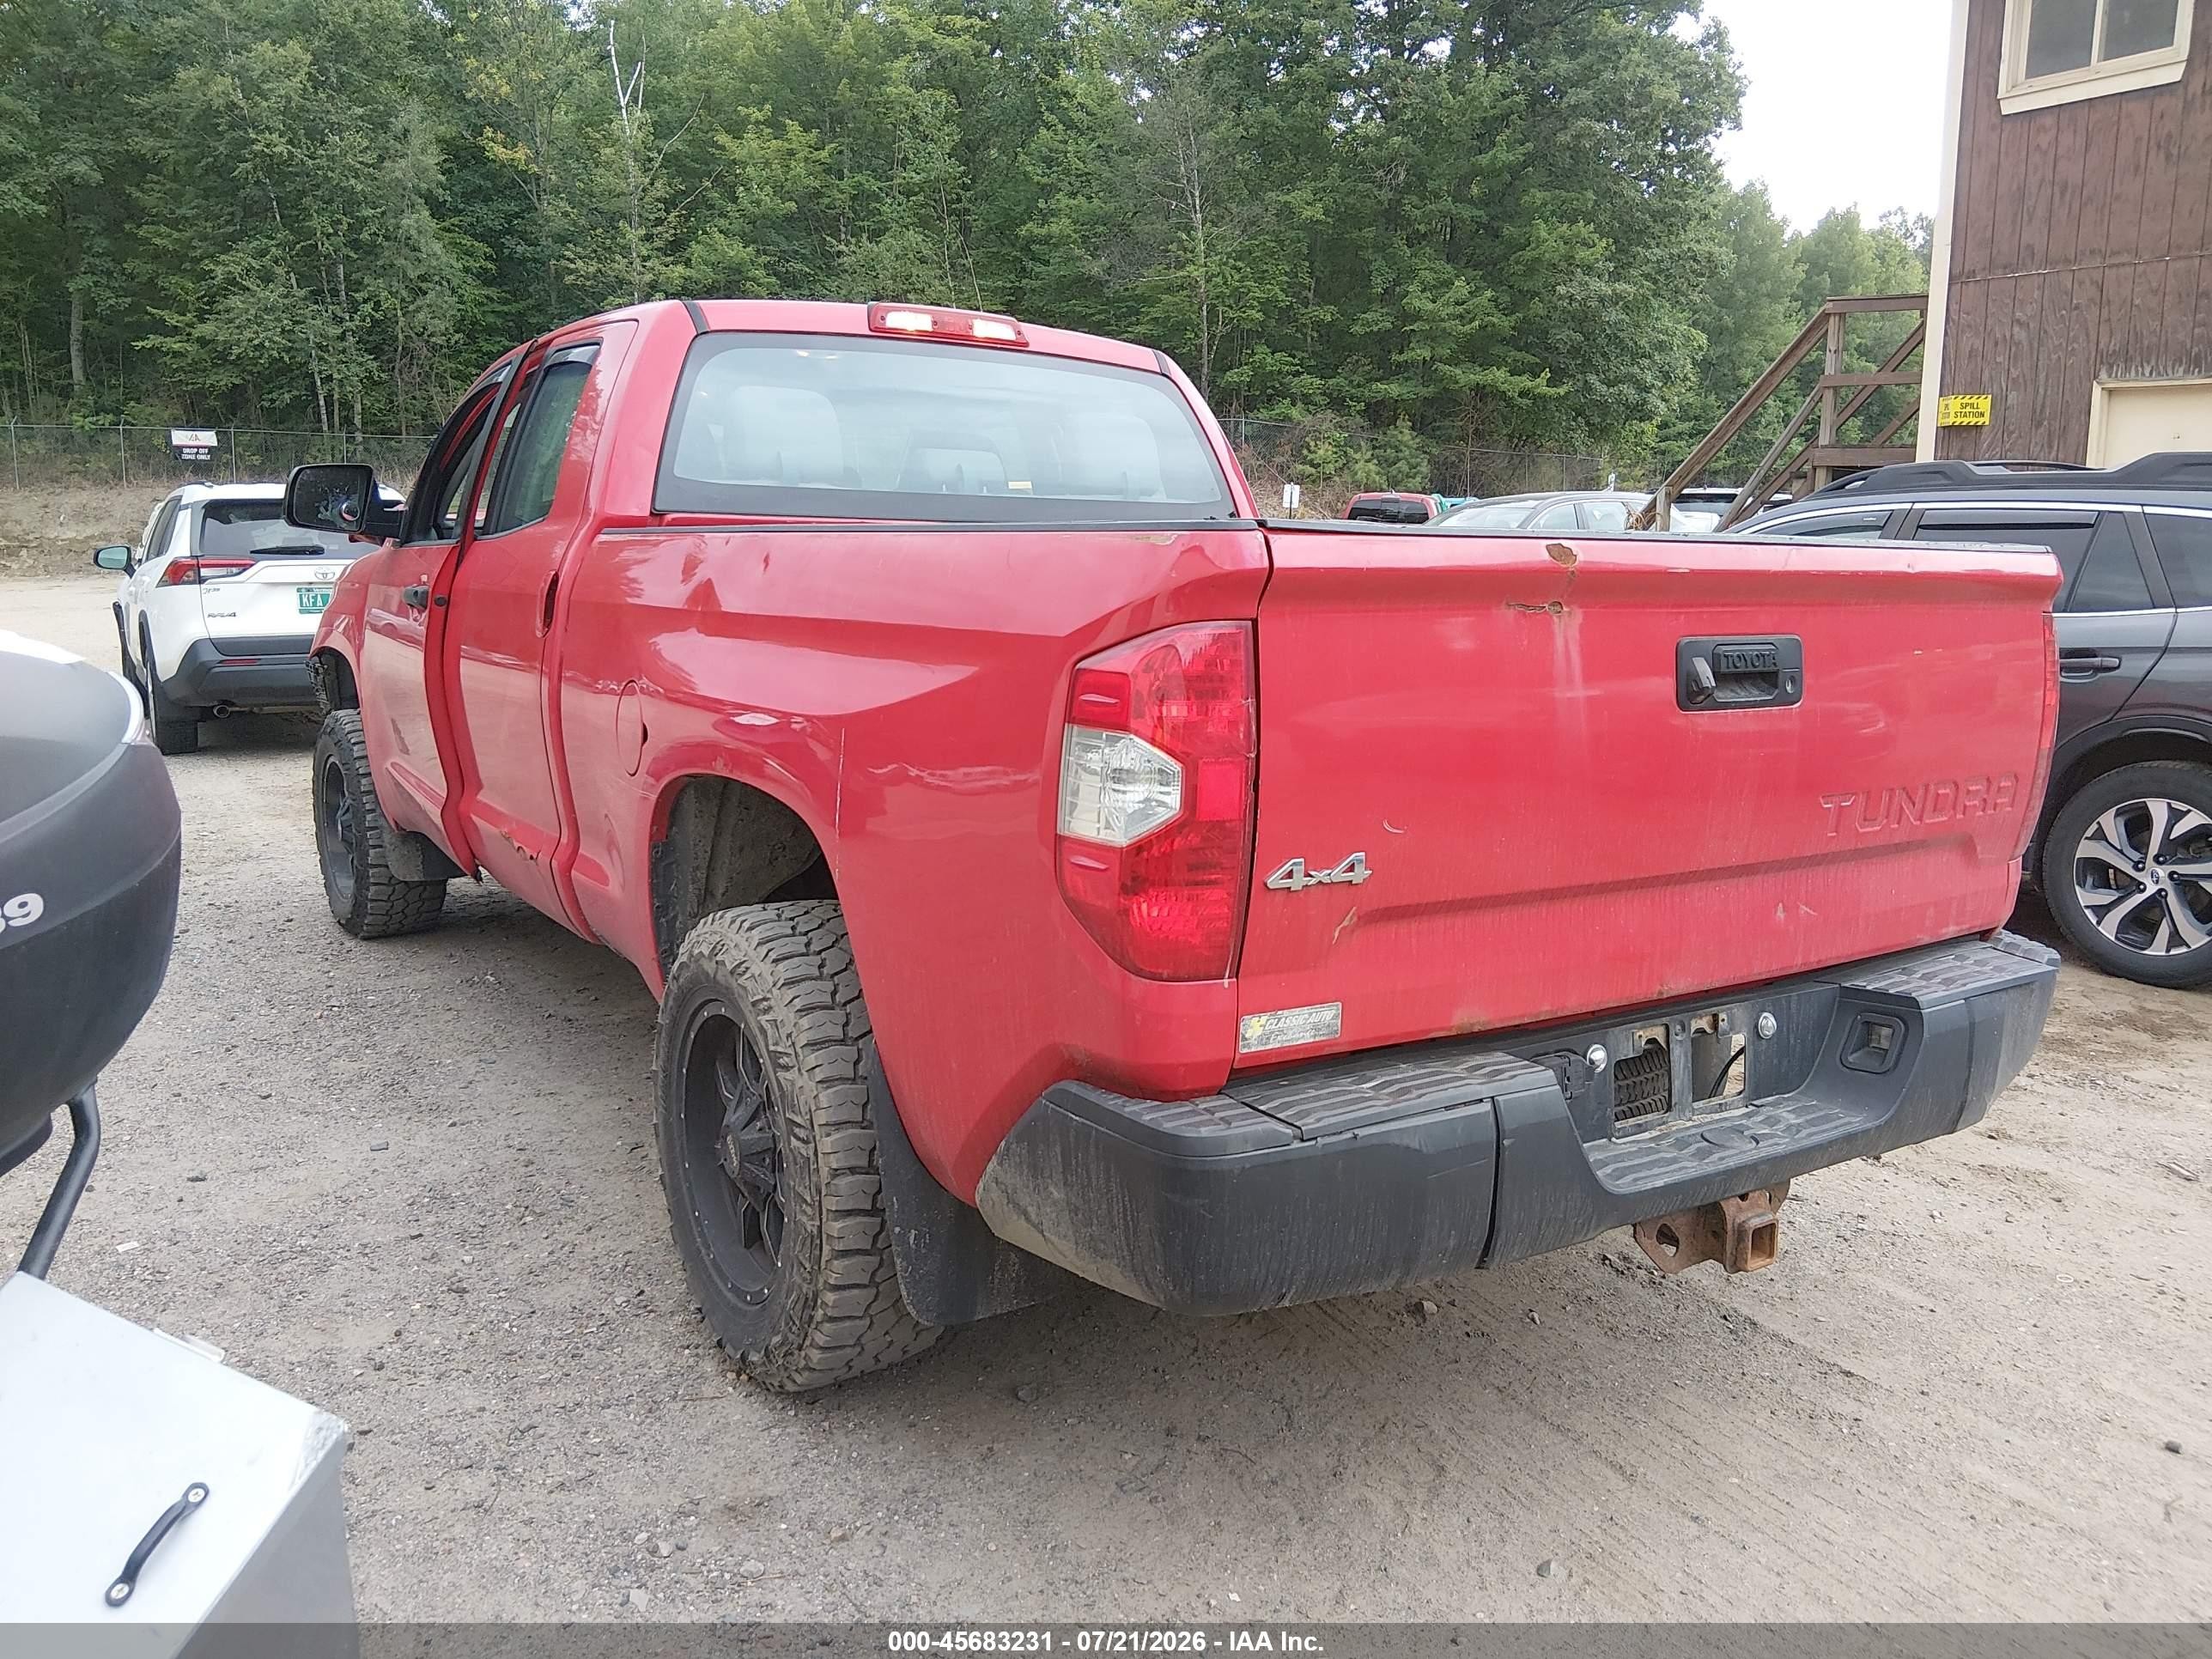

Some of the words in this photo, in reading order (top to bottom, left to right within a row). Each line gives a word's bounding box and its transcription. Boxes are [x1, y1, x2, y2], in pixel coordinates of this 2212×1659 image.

[1954, 410, 1985, 419] STATION
[302, 593, 323, 607] KFA
[1723, 650, 1778, 670] TOYOTA
[1820, 772, 2020, 836] TUNDRA
[0, 892, 45, 933] 9
[1265, 1014, 1310, 1030] CLASSIC
[1307, 1009, 1336, 1023] AUTO
